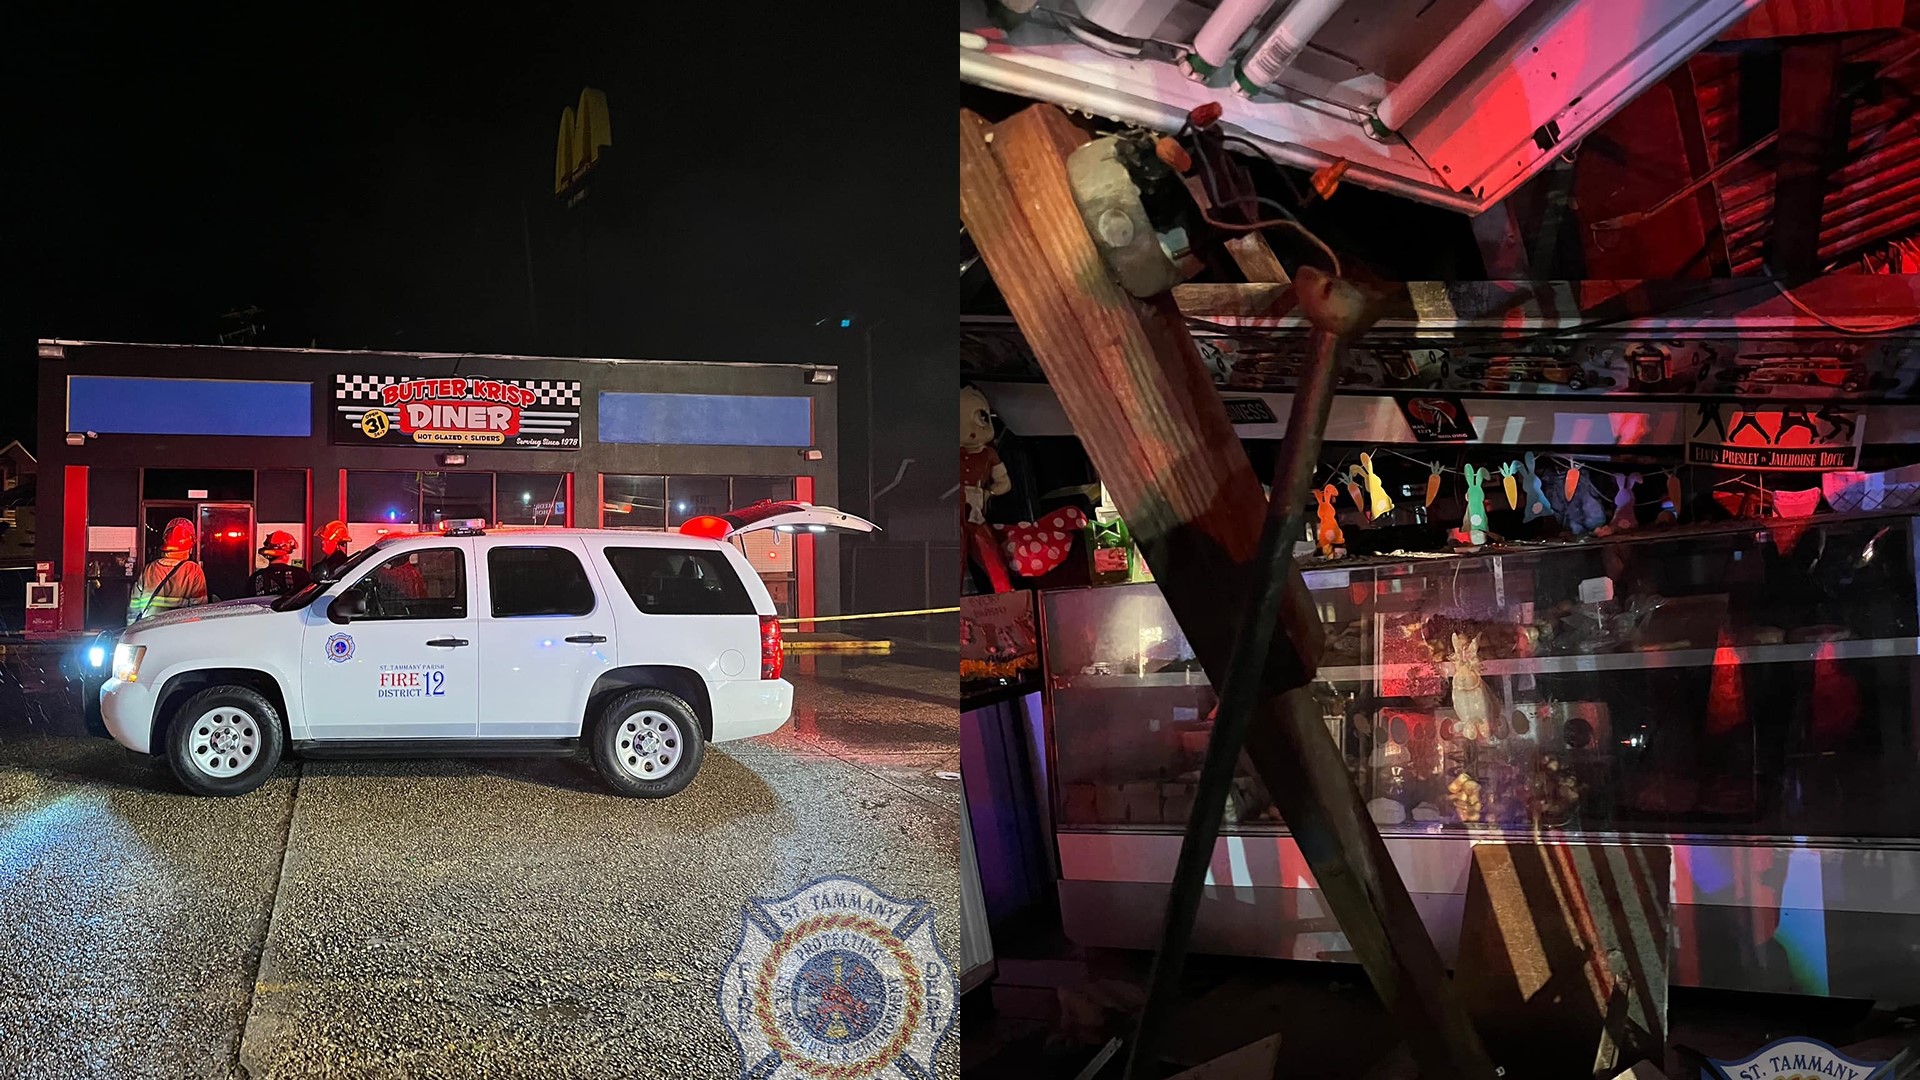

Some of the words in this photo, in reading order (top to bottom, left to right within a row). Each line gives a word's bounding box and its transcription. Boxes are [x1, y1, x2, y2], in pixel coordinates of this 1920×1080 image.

[382, 378, 467, 405] BUTTER
[473, 379, 536, 408] KRISP
[364, 415, 386, 434] 31
[406, 403, 512, 431] DINER
[470, 434, 501, 442] SLIDERS
[516, 437, 542, 448] Serving
[542, 438, 560, 446] Since
[560, 438, 579, 446] 1978
[1695, 446, 1719, 462] ELVIS
[1722, 449, 1760, 466] PRESLEY
[1820, 451, 1845, 467] ROCK
[379, 672, 420, 688] FIRE
[422, 670, 445, 697] 12
[378, 688, 422, 698] DISTRICT
